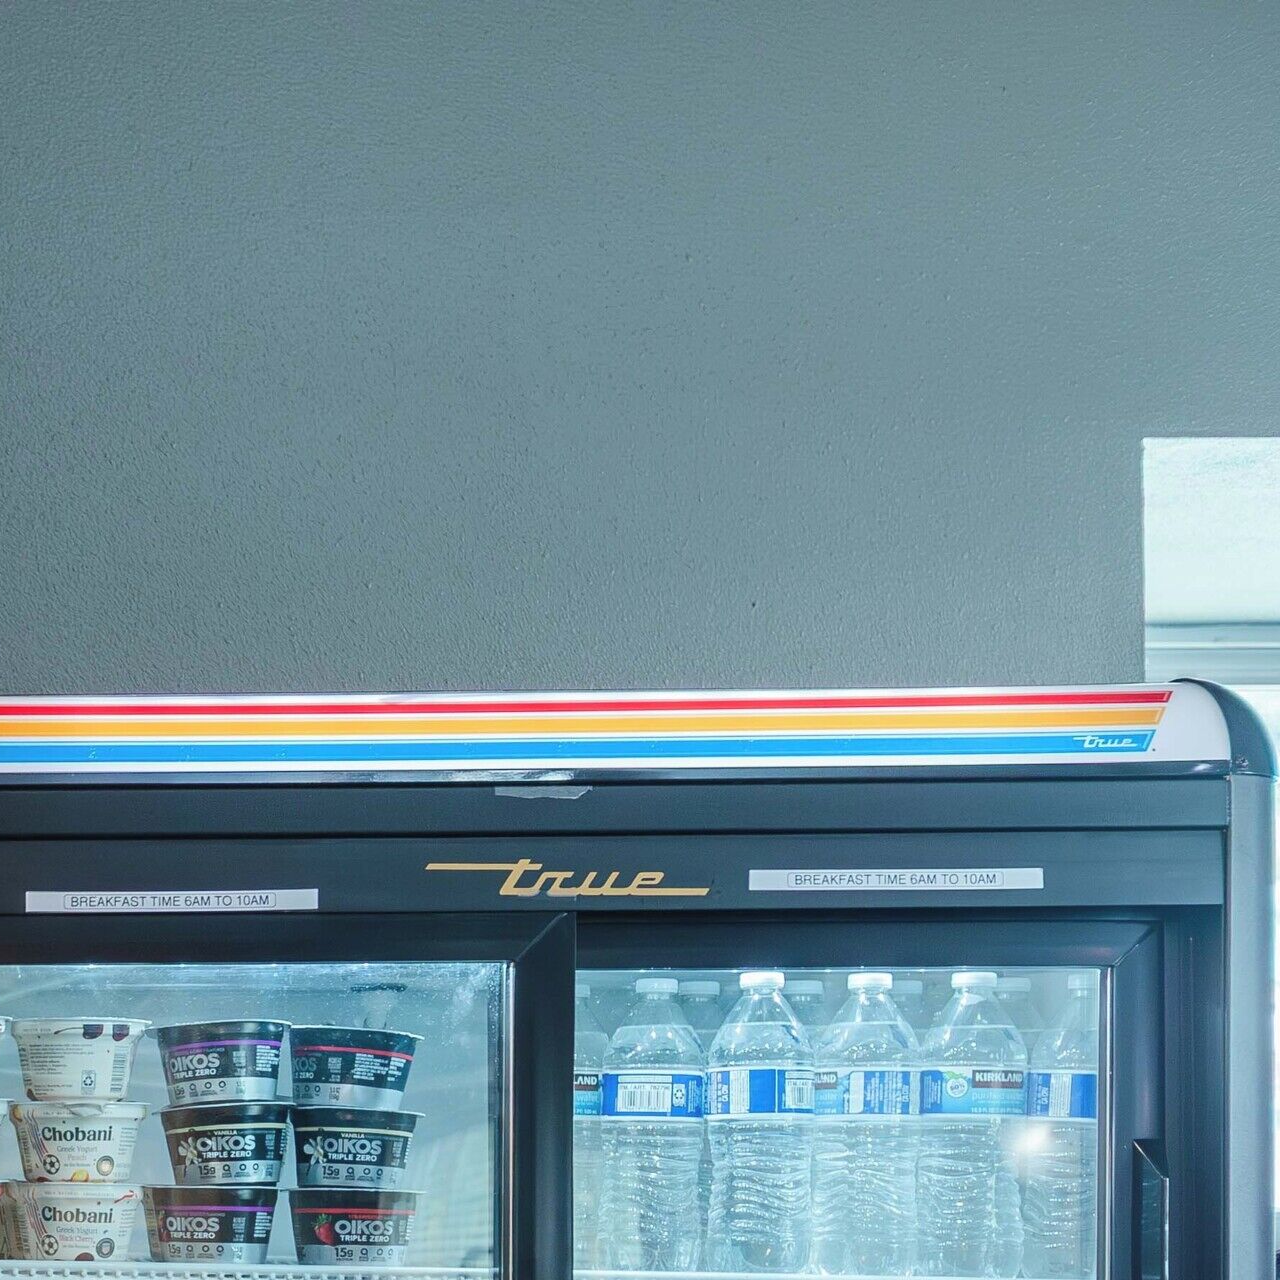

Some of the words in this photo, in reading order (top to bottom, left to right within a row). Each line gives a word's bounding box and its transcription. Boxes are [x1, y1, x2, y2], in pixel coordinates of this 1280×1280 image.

[1073, 735, 1138, 748] true
[426, 859, 709, 897] true
[794, 873, 871, 885] BREAKFAST
[876, 873, 907, 885] TIME
[910, 873, 937, 885] 6AM
[941, 873, 959, 884] TO
[963, 873, 997, 884] 10AM
[70, 895, 146, 907] BREAKFAST
[151, 895, 181, 907] TIME
[184, 895, 211, 907] 6AM
[215, 895, 233, 906] TO
[237, 895, 270, 906] 10AM
[170, 1052, 220, 1073] OIKOS
[195, 1068, 217, 1076] ZERO
[975, 1072, 1023, 1082] KIRKLAND
[41, 1126, 113, 1142] Chobani
[196, 1134, 256, 1151] OIKOS
[324, 1138, 382, 1155] OIKOS
[202, 1151, 228, 1159] TRIPLE
[230, 1150, 252, 1158] ZERO
[328, 1153, 354, 1161] TRIPLE
[356, 1154, 377, 1162] ZERO
[198, 1165, 216, 1176] 15g
[322, 1166, 340, 1177] 15g
[41, 1205, 113, 1223] Chobani
[166, 1216, 220, 1232] OIKOS
[334, 1219, 394, 1236] OIKOS
[170, 1231, 191, 1239] TRIPLE
[193, 1231, 216, 1239] ZERO
[335, 1247, 354, 1258] 15g
